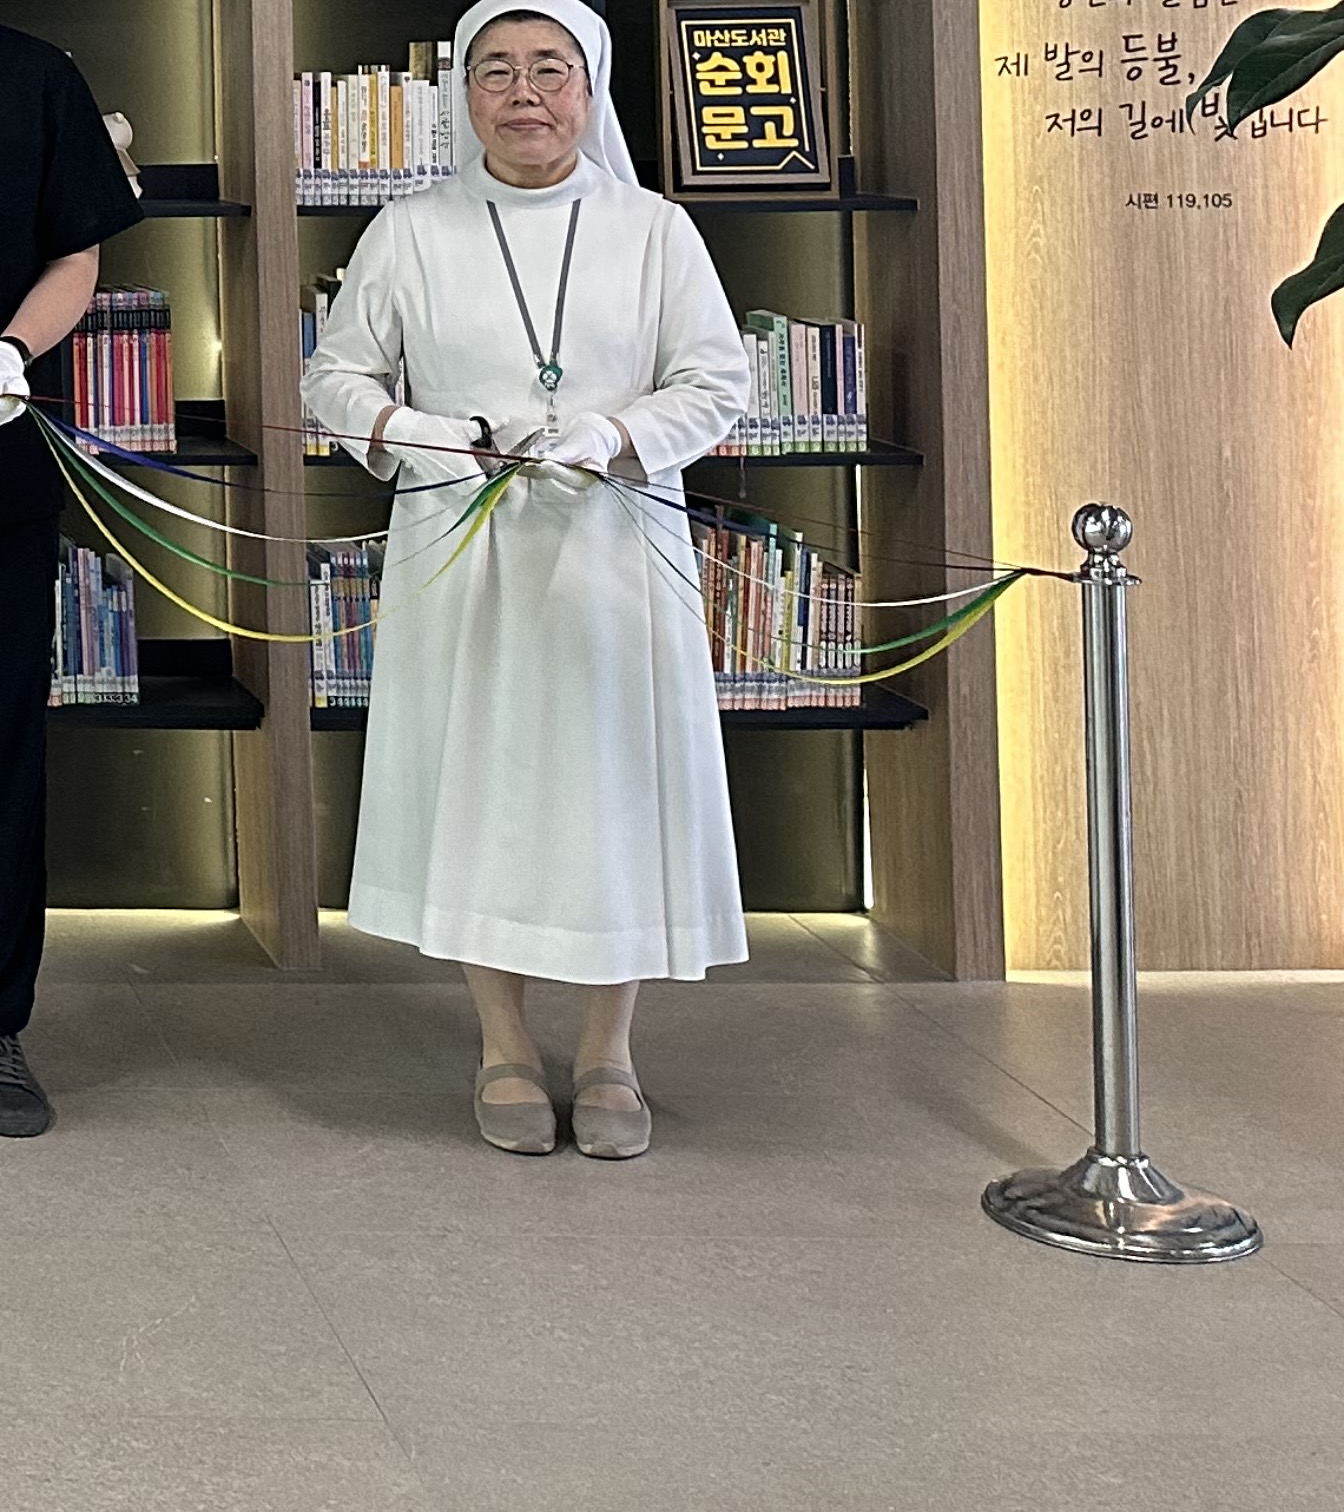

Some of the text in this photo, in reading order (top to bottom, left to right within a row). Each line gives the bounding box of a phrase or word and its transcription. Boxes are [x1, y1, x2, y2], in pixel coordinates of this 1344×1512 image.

[693, 29, 787, 47] 마산도서관
[995, 32, 1196, 85] 제 발의 등불,
[695, 50, 793, 96] 순회
[701, 105, 800, 150] 문고
[1045, 108, 1103, 138] 저의
[1118, 101, 1185, 140] 길에
[1125, 192, 1159, 209] 시편
